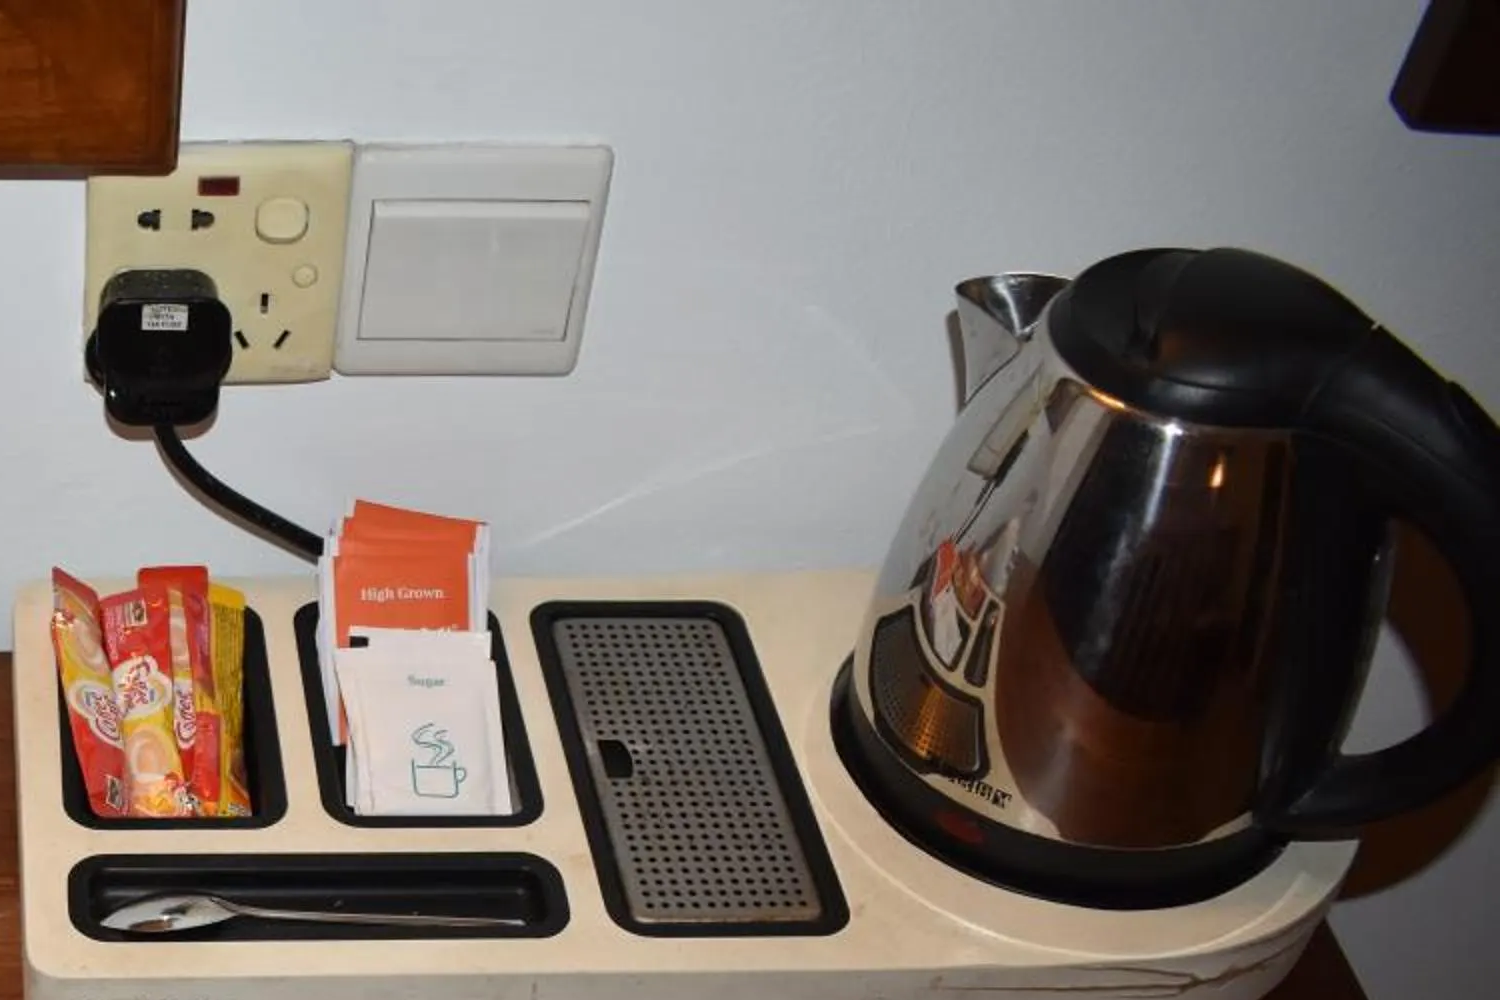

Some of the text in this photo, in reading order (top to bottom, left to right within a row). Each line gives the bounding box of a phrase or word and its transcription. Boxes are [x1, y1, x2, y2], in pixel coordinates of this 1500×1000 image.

[361, 587, 444, 603] High Grown
[407, 674, 445, 689] Sugar
